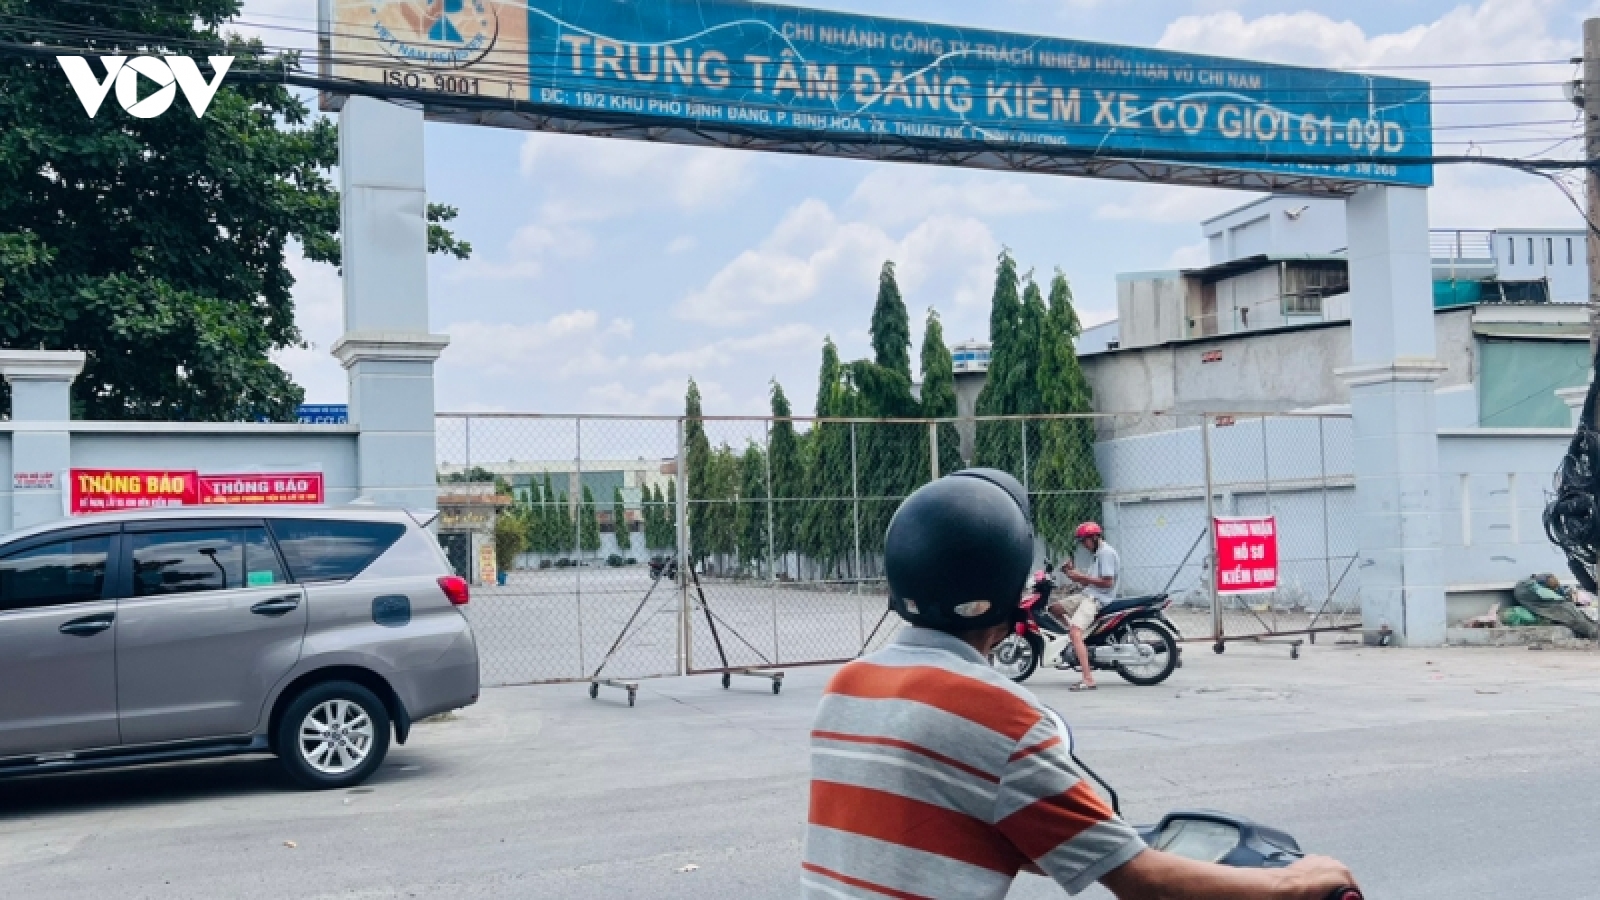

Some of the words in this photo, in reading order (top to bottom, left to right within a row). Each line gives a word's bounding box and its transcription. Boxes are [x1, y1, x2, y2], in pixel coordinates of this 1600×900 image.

[782, 21, 815, 42] CHI
[819, 24, 885, 49] NHÁNH
[890, 31, 944, 55] CÔNG
[949, 40, 971, 59] TY
[976, 42, 1034, 66] TRÁCH
[1039, 51, 1092, 75] NHIỆM
[1095, 55, 1131, 77] HỮU
[1135, 61, 1169, 82] HẠN
[1173, 64, 1195, 83] VŨ
[1198, 69, 1224, 86] CHI
[1227, 74, 1262, 92] NAM
[383, 69, 427, 90] ISO:
[433, 73, 479, 95] 9001
[561, 34, 732, 90] TRUNG
[743, 48, 840, 100] TÂM
[852, 61, 973, 113] ĐĂNG
[984, 75, 1082, 123] KIỂM
[1092, 91, 1141, 129] XE
[1151, 97, 1209, 136] CƠ
[1216, 100, 1291, 142] GIỚI
[1300, 112, 1405, 153] 61-09D
[575, 91, 605, 109] 19/2
[610, 95, 644, 112] KHU
[78, 471, 141, 494] THÔNG
[146, 472, 186, 494] BÁO
[211, 478, 269, 495] THÔNG
[273, 477, 309, 493] BÁO
[1221, 564, 1251, 585] KIỂM
